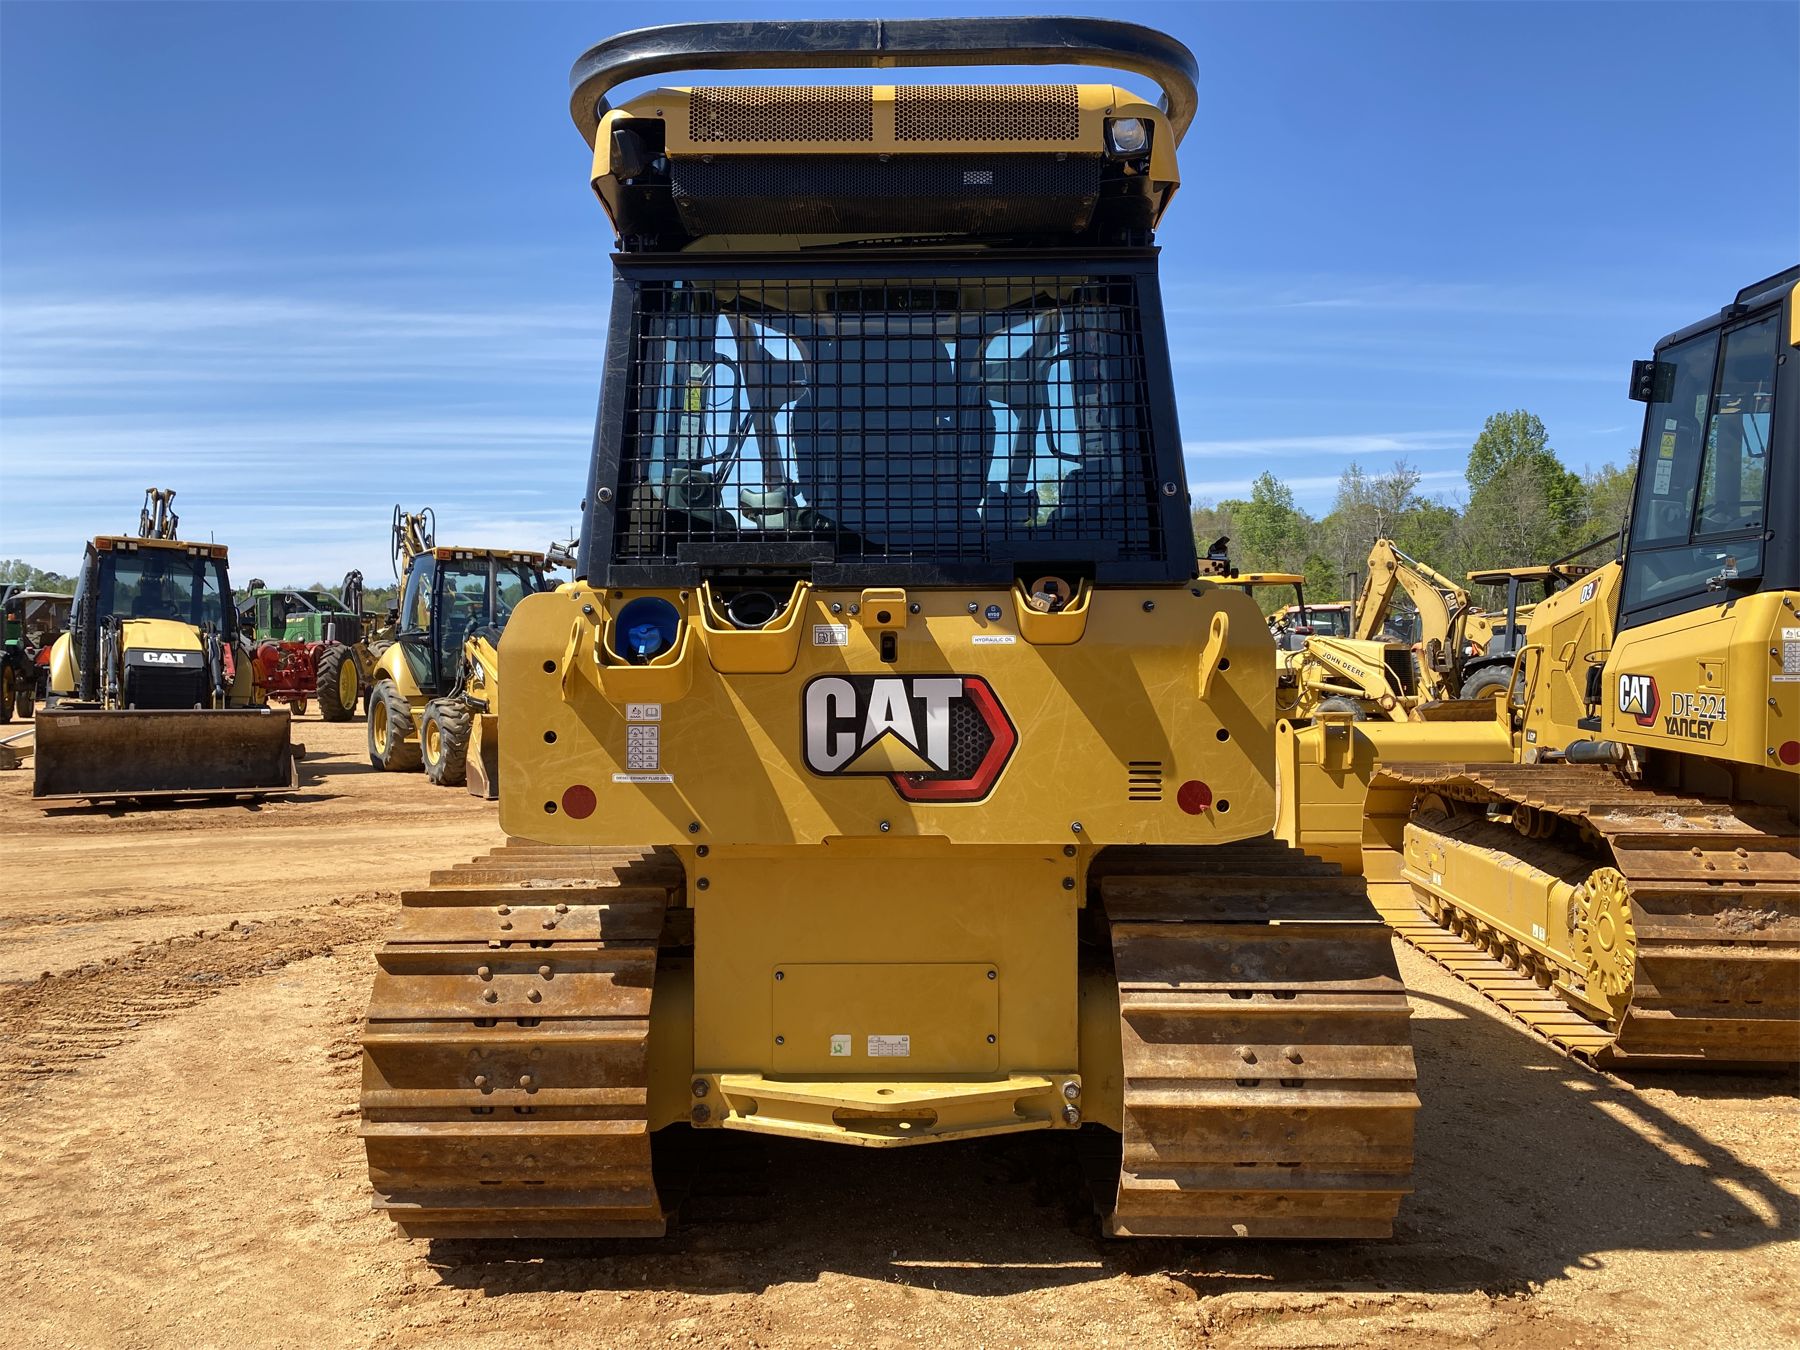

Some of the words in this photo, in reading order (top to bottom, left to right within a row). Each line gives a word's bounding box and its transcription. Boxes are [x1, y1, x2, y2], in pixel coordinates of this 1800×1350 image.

[1444, 593, 1459, 611] CAT
[1580, 583, 1594, 603] D3
[143, 652, 186, 664] CAT
[1322, 652, 1340, 665] JOHN
[1342, 662, 1365, 677] DEERE
[1619, 673, 1651, 714] CAT
[1671, 692, 1726, 721] DF-224
[806, 677, 963, 772] CAT
[1664, 716, 1714, 741] YANCEY
